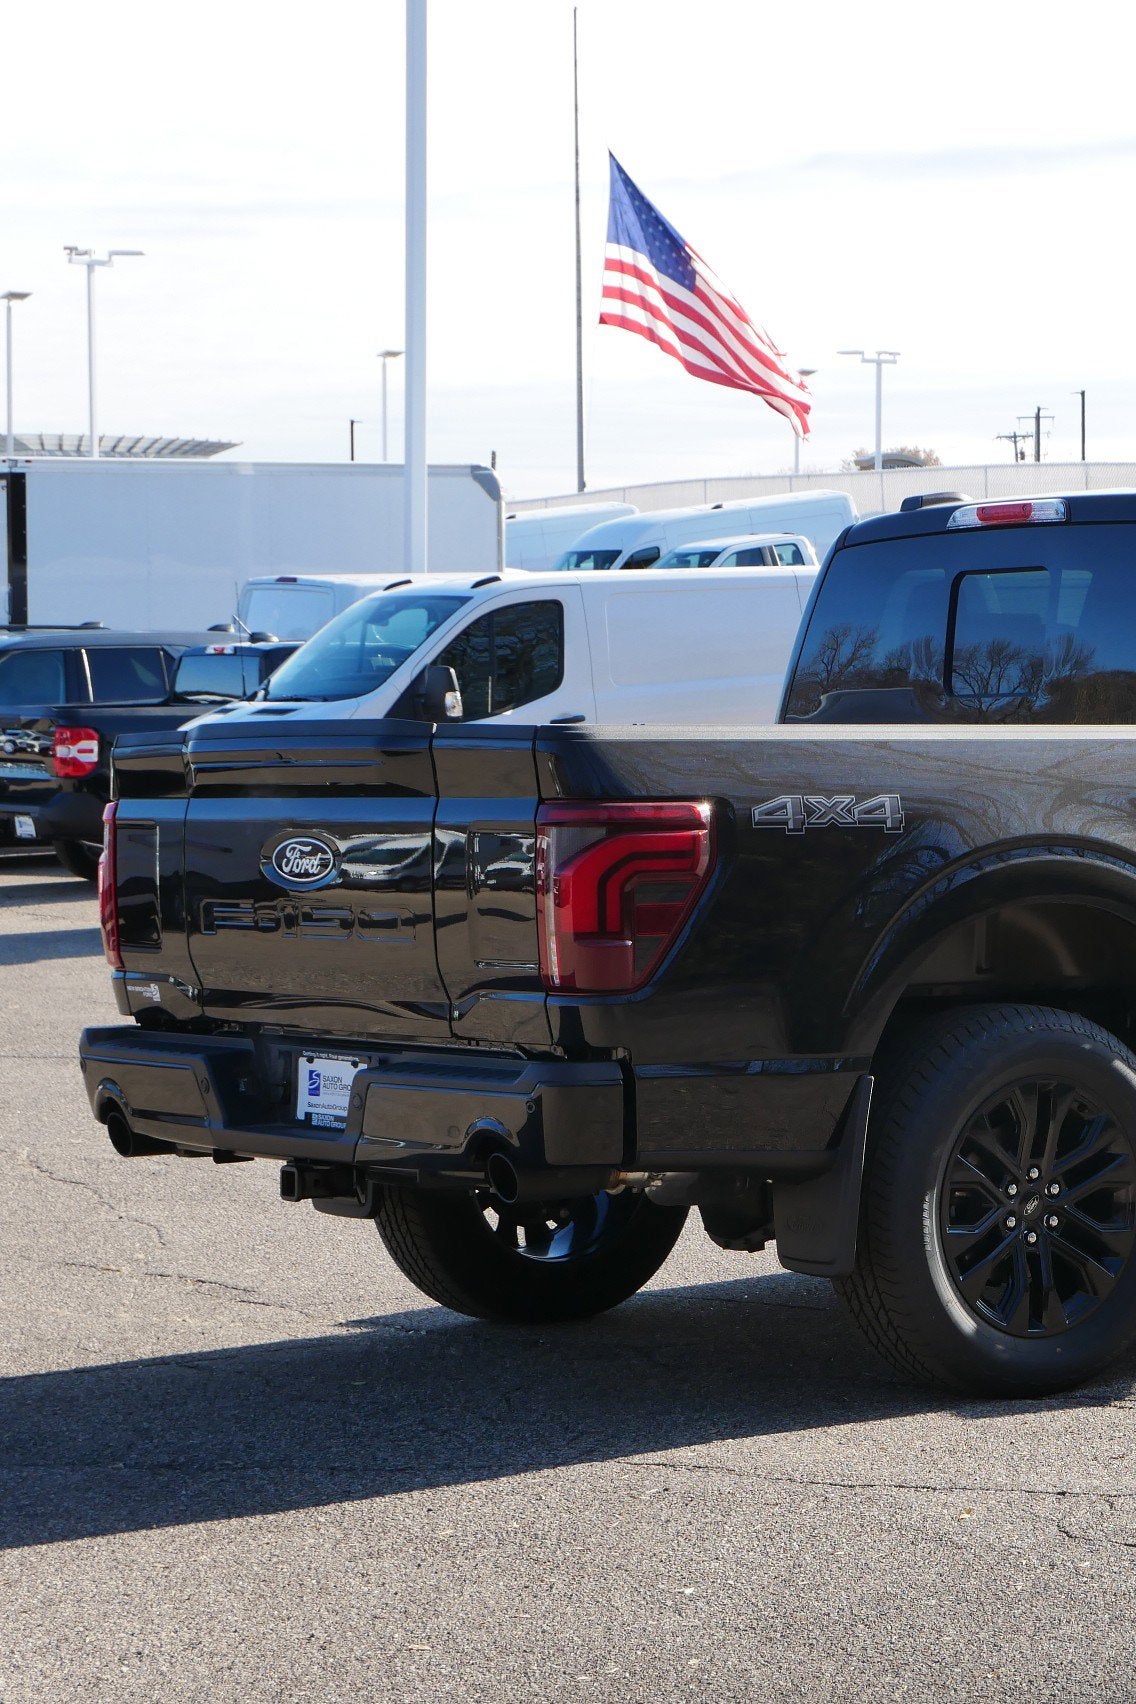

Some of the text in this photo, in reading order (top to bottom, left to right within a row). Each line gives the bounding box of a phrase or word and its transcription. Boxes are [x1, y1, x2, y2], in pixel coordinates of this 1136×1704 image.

[282, 844, 321, 874] Ford
[322, 1075, 342, 1083] SAXON
[322, 1082, 351, 1092] AUTO GRO
